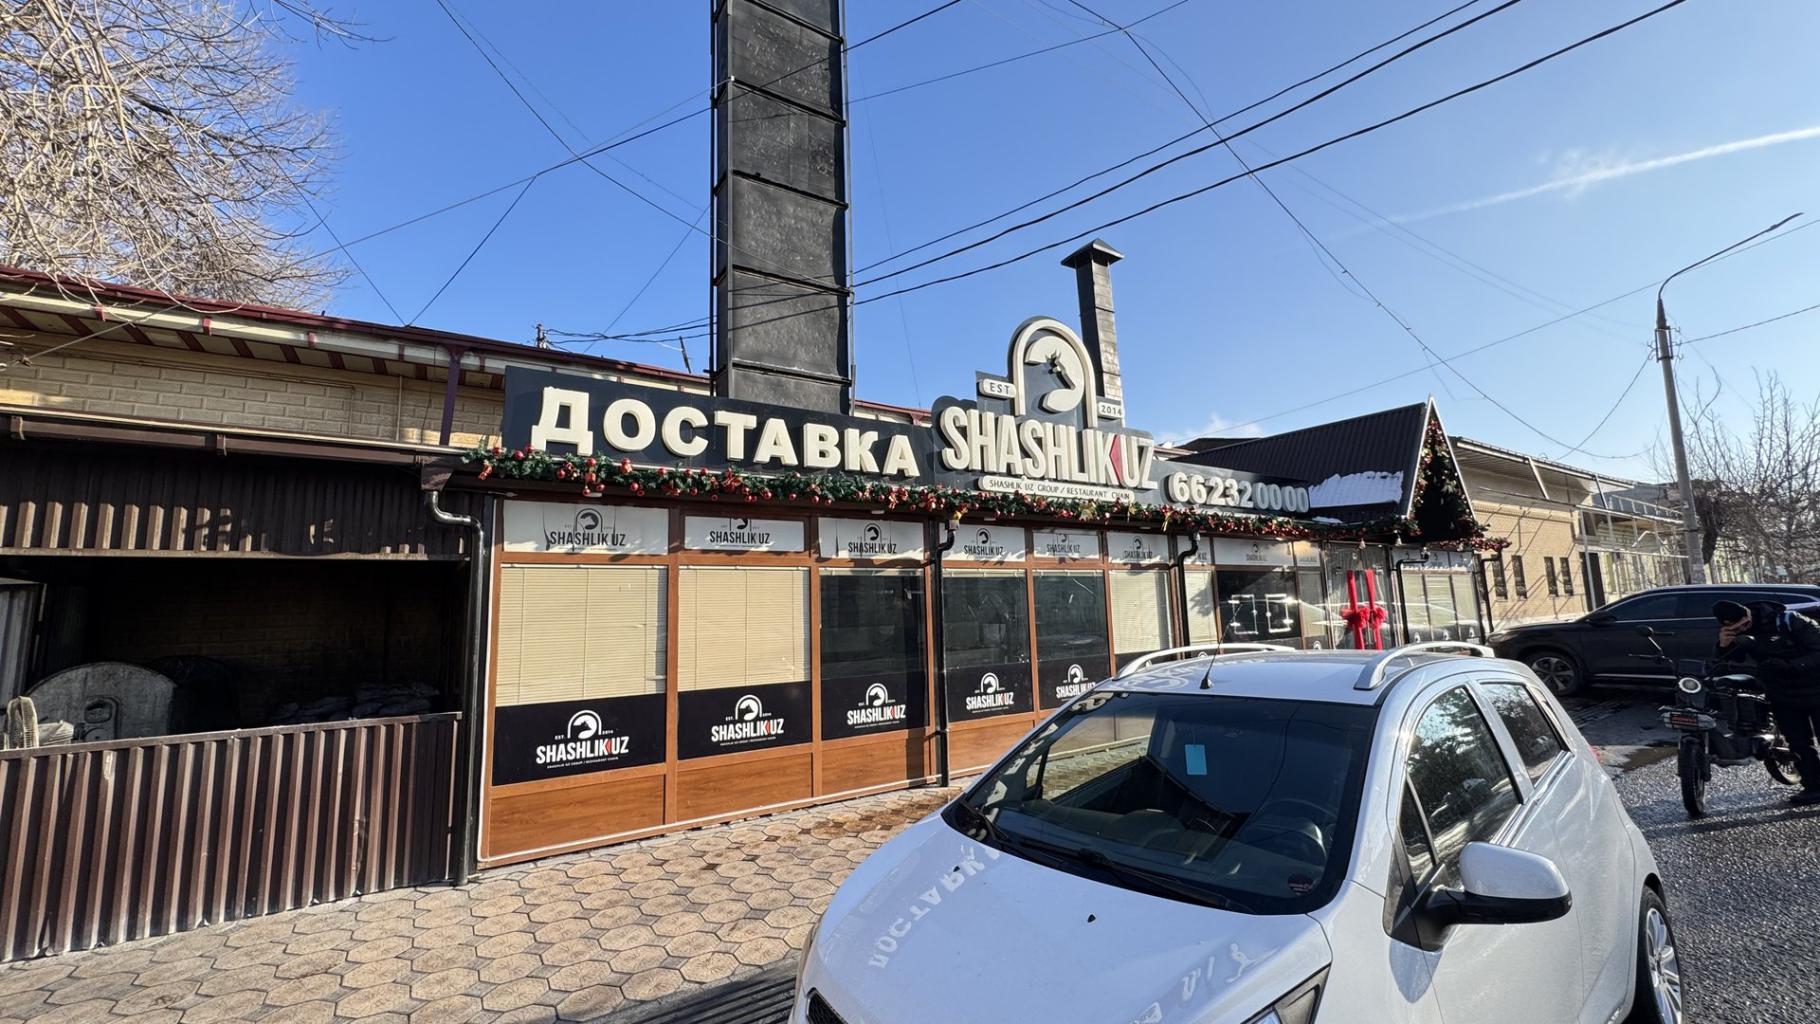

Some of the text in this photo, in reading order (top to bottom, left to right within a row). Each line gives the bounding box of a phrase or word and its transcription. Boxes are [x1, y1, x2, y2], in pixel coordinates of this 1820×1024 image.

[989, 382, 1011, 395] EST
[1100, 405, 1122, 416] 2014
[531, 386, 920, 477] ДОСТАВКА
[989, 479, 1022, 490] SHASHLIK
[1037, 484, 1060, 493] GROUP
[1066, 486, 1107, 498] RESTAURANT
[550, 531, 627, 547] SHASHLIK UZ
[709, 530, 771, 545] SHASHLIK UZ
[848, 541, 886, 555] SHASHLIK
